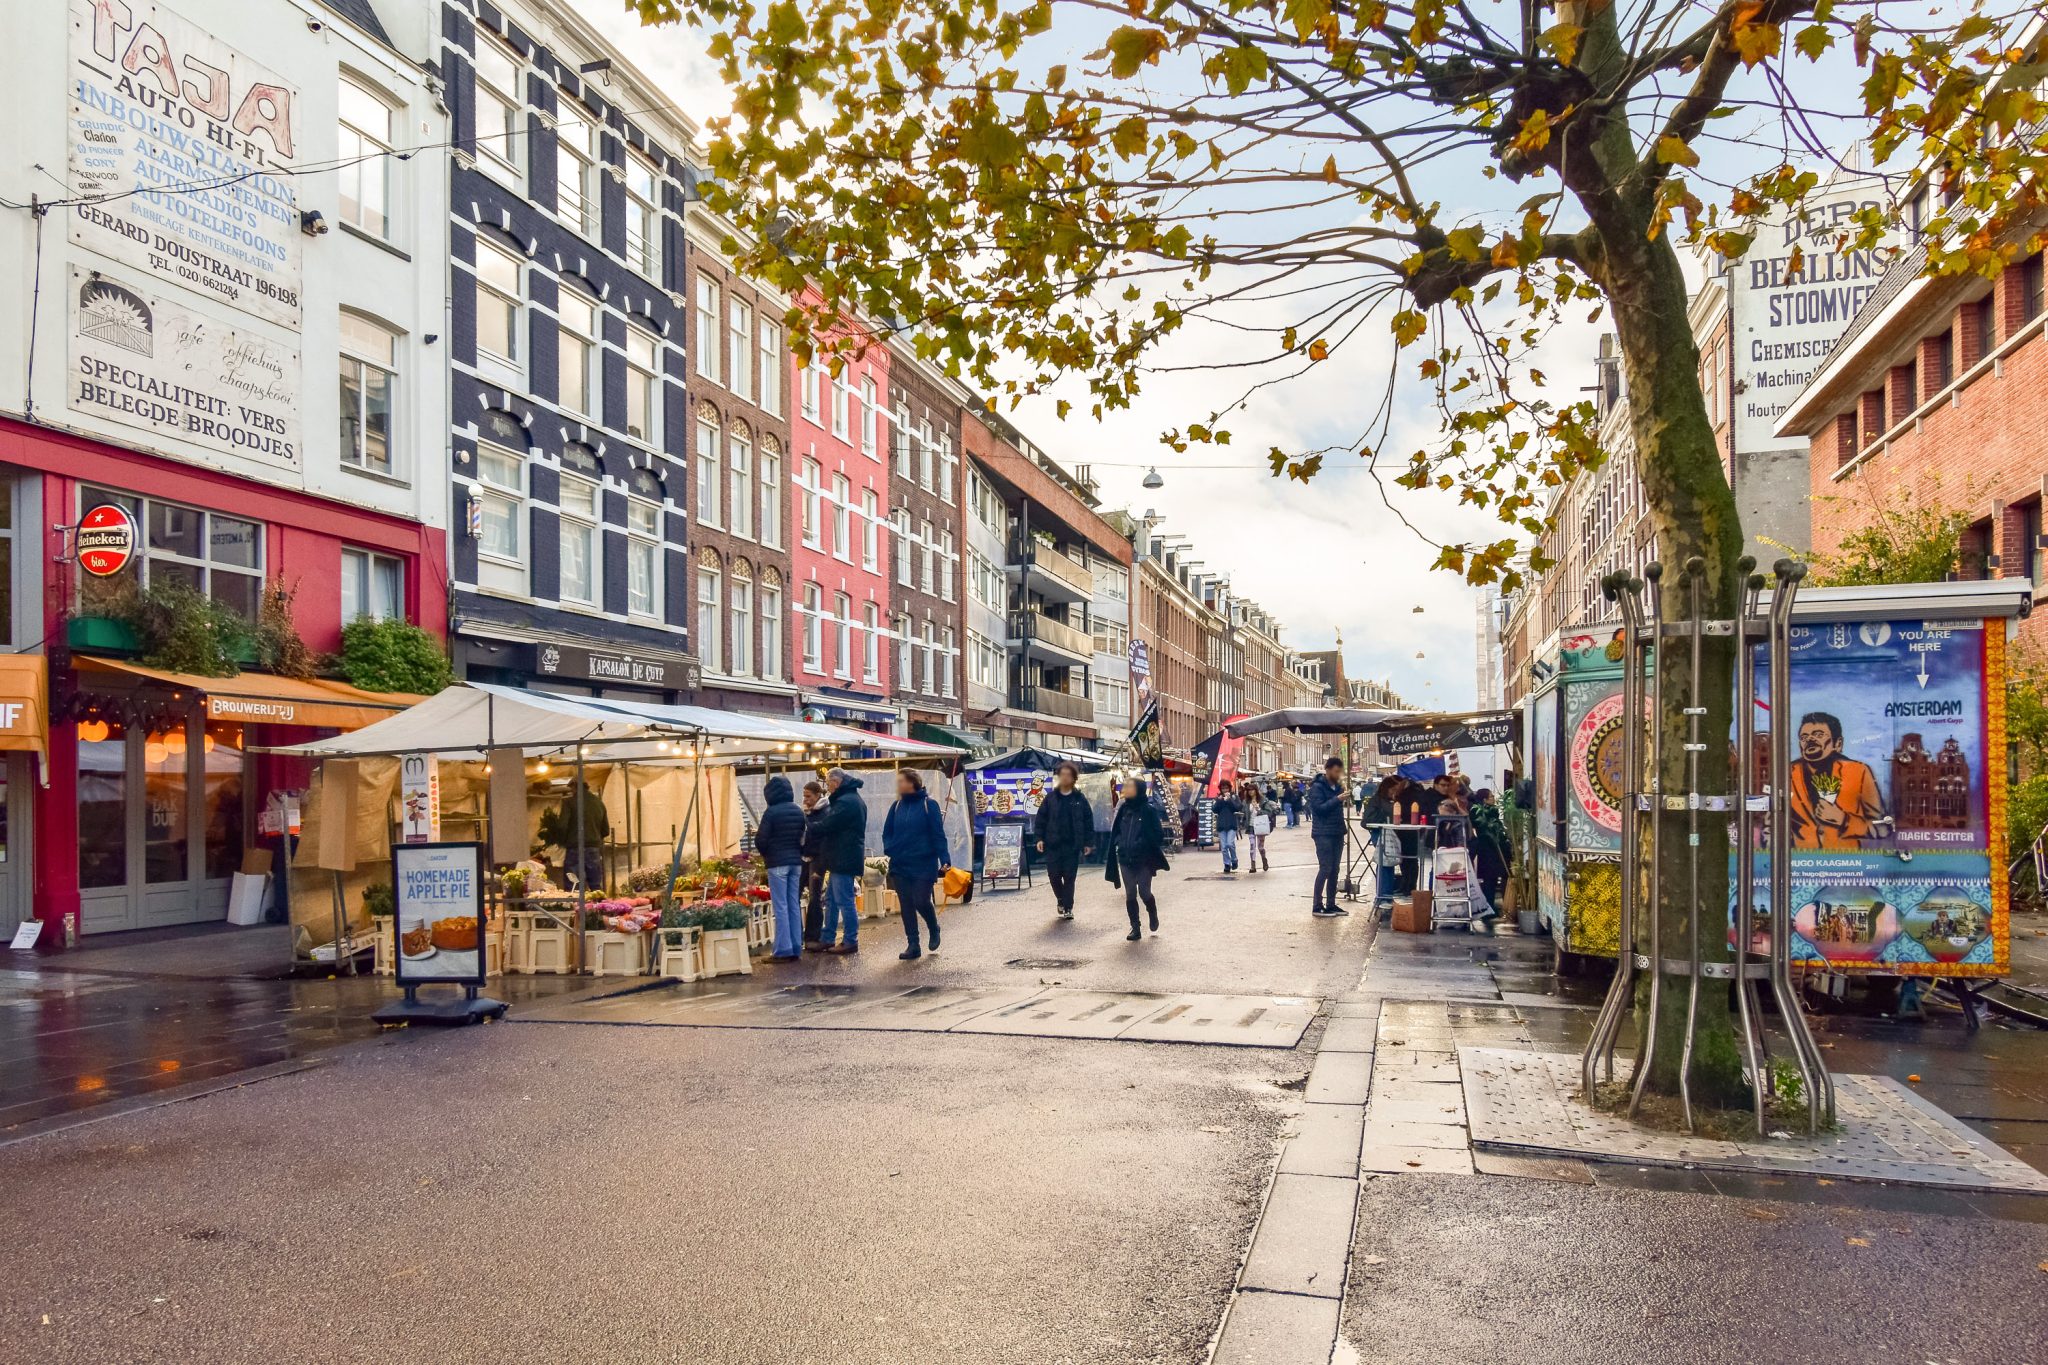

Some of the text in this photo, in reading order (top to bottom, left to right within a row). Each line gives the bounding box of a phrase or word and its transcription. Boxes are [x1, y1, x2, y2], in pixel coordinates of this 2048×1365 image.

[86, 0, 293, 159] TAJA
[114, 74, 264, 166] AUTO HI-FI
[78, 79, 294, 205] INBOUWSTATION
[84, 129, 117, 143] Clarion
[89, 146, 124, 155] PIONEER
[85, 158, 115, 168] SONY
[80, 172, 119, 180] KENWOOD
[134, 138, 291, 226] ALARMSYSTEMEN
[133, 160, 257, 228] AUTORADIO'S
[134, 181, 286, 261] AUTOTELEFOONS
[78, 203, 149, 244] GERARD
[154, 234, 252, 288] DOUSTRAAT
[131, 202, 274, 272] FABRICAGE KENTEKENPLATEN
[148, 253, 173, 273] TEL.
[215, 367, 293, 405] chaapskooi
[80, 355, 287, 435] SPECIALITEIT: VERS
[80, 381, 294, 459] BELEGDE BROODJES
[79, 532, 126, 547] Heineken
[91, 555, 107, 568] bier
[1898, 631, 1951, 640] YOU ARE
[1909, 643, 1941, 651] HERE
[589, 657, 630, 677] KAPSALON
[212, 700, 276, 715] BROUWERIJ
[1885, 700, 1961, 717] AMSTERDAM
[1898, 832, 1974, 842] MAGIC SENTER
[1816, 859, 1862, 868] KAAGMAN
[406, 869, 470, 883] HOMEMADE
[407, 884, 470, 899] APPLE PIE
